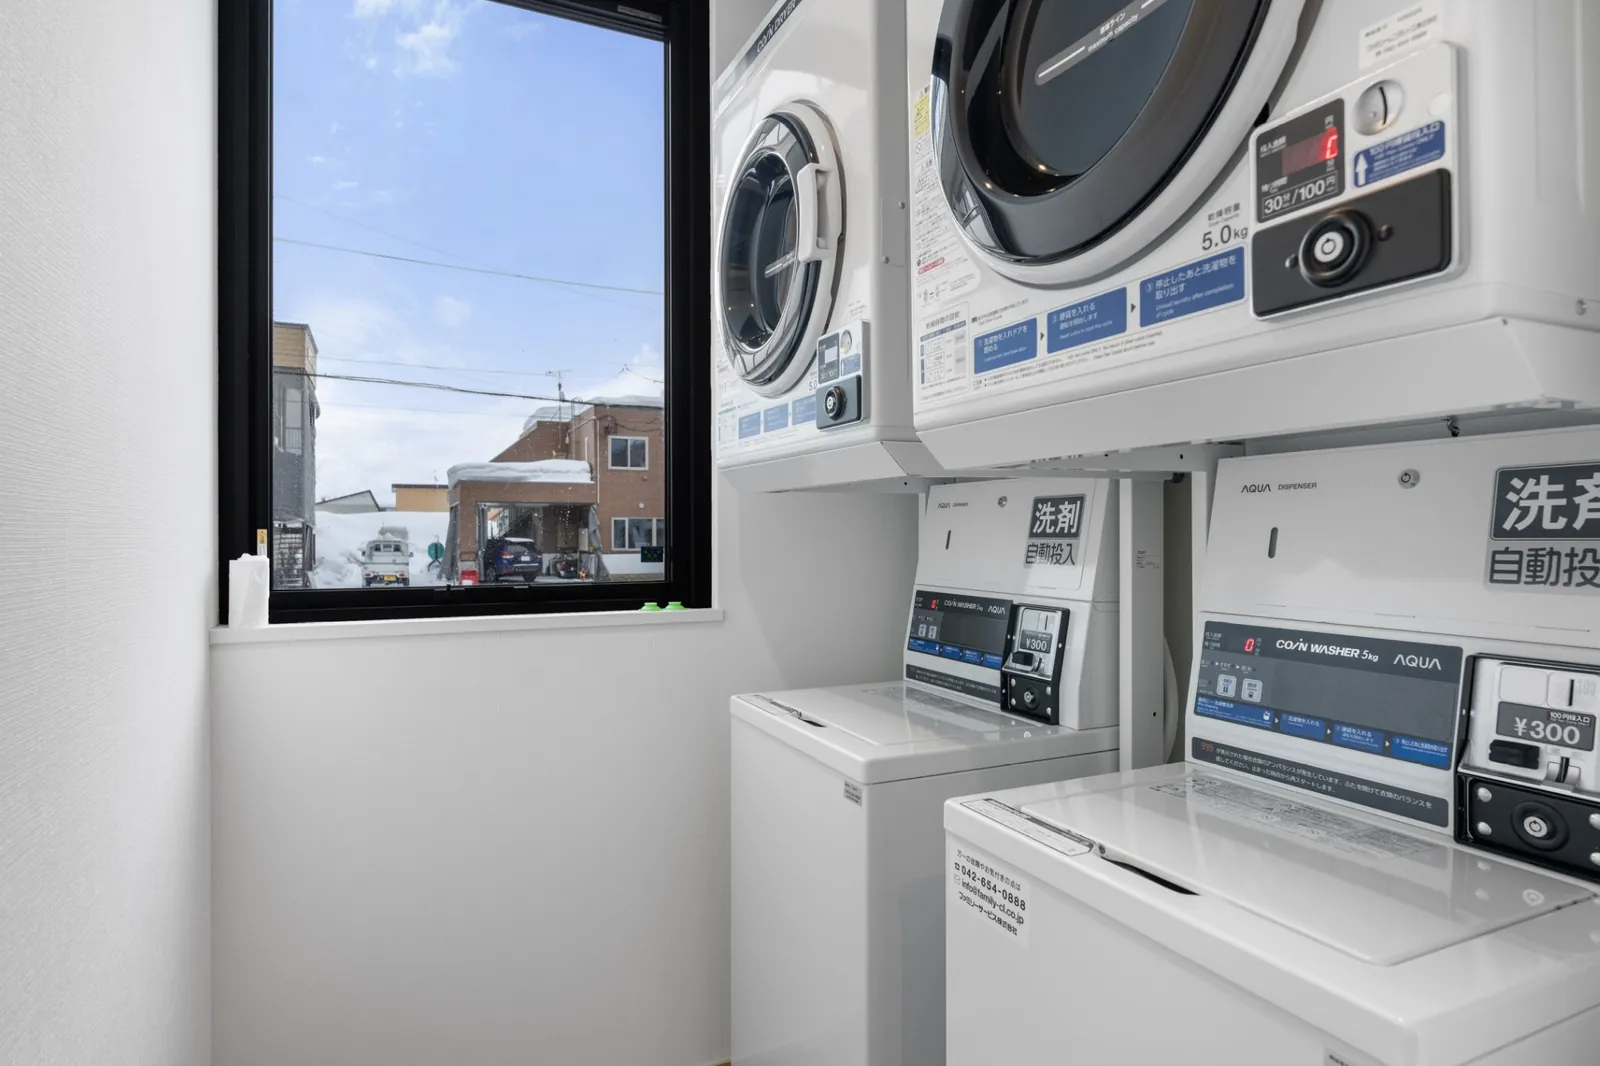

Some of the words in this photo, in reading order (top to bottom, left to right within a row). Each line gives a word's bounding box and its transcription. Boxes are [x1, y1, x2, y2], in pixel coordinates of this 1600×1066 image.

[1088, 31, 1114, 52] maximum
[1114, 13, 1139, 35] capacity
[1155, 254, 1237, 288] 停止したあと洗濯物を
[1155, 282, 1186, 301] 取り出す
[1241, 483, 1272, 493] AQUA
[1278, 482, 1318, 491] DISPENSER
[1033, 500, 1081, 535] 洗剤
[1025, 543, 1076, 567] 自動投入
[988, 605, 1006, 615] AQUA
[1026, 637, 1048, 652] ¥300
[1244, 638, 1256, 652] 0
[1310, 643, 1360, 659] WASHER
[1361, 650, 1379, 663] 5kg
[1393, 653, 1443, 670] AQUA
[1514, 716, 1581, 745] ¥300
[961, 865, 1027, 911] 042-654-0888
[958, 890, 1019, 936] ファミリーサービス株式会社
[961, 878, 1025, 925] info@family-cl.co.jp
